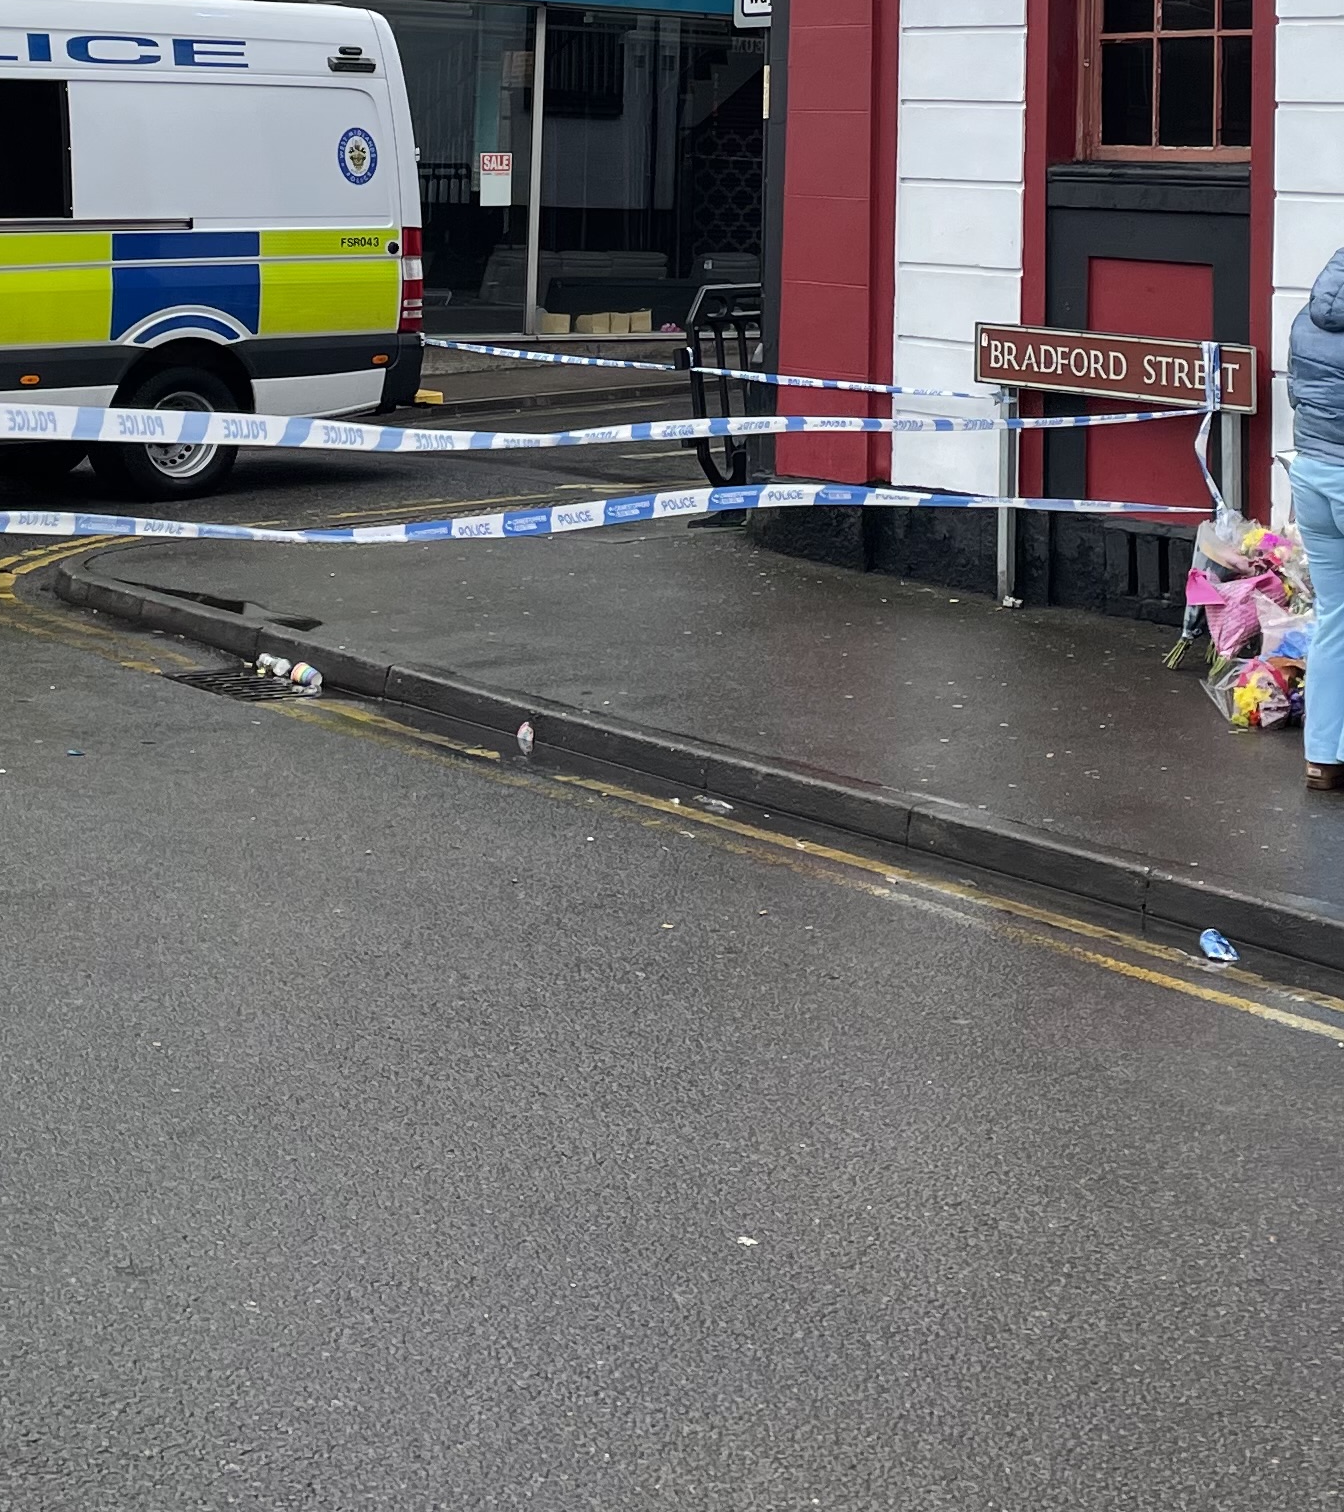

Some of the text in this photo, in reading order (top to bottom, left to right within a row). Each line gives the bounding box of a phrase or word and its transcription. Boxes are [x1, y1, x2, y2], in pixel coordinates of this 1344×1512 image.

[482, 155, 510, 171] SALE
[340, 236, 380, 248] FSR043
[989, 339, 1240, 394] BRADFORD STRET
[767, 489, 804, 502] POLICE
[660, 496, 697, 512] POLICE
[557, 509, 594, 527] POLICE
[458, 522, 493, 538] POLICE
